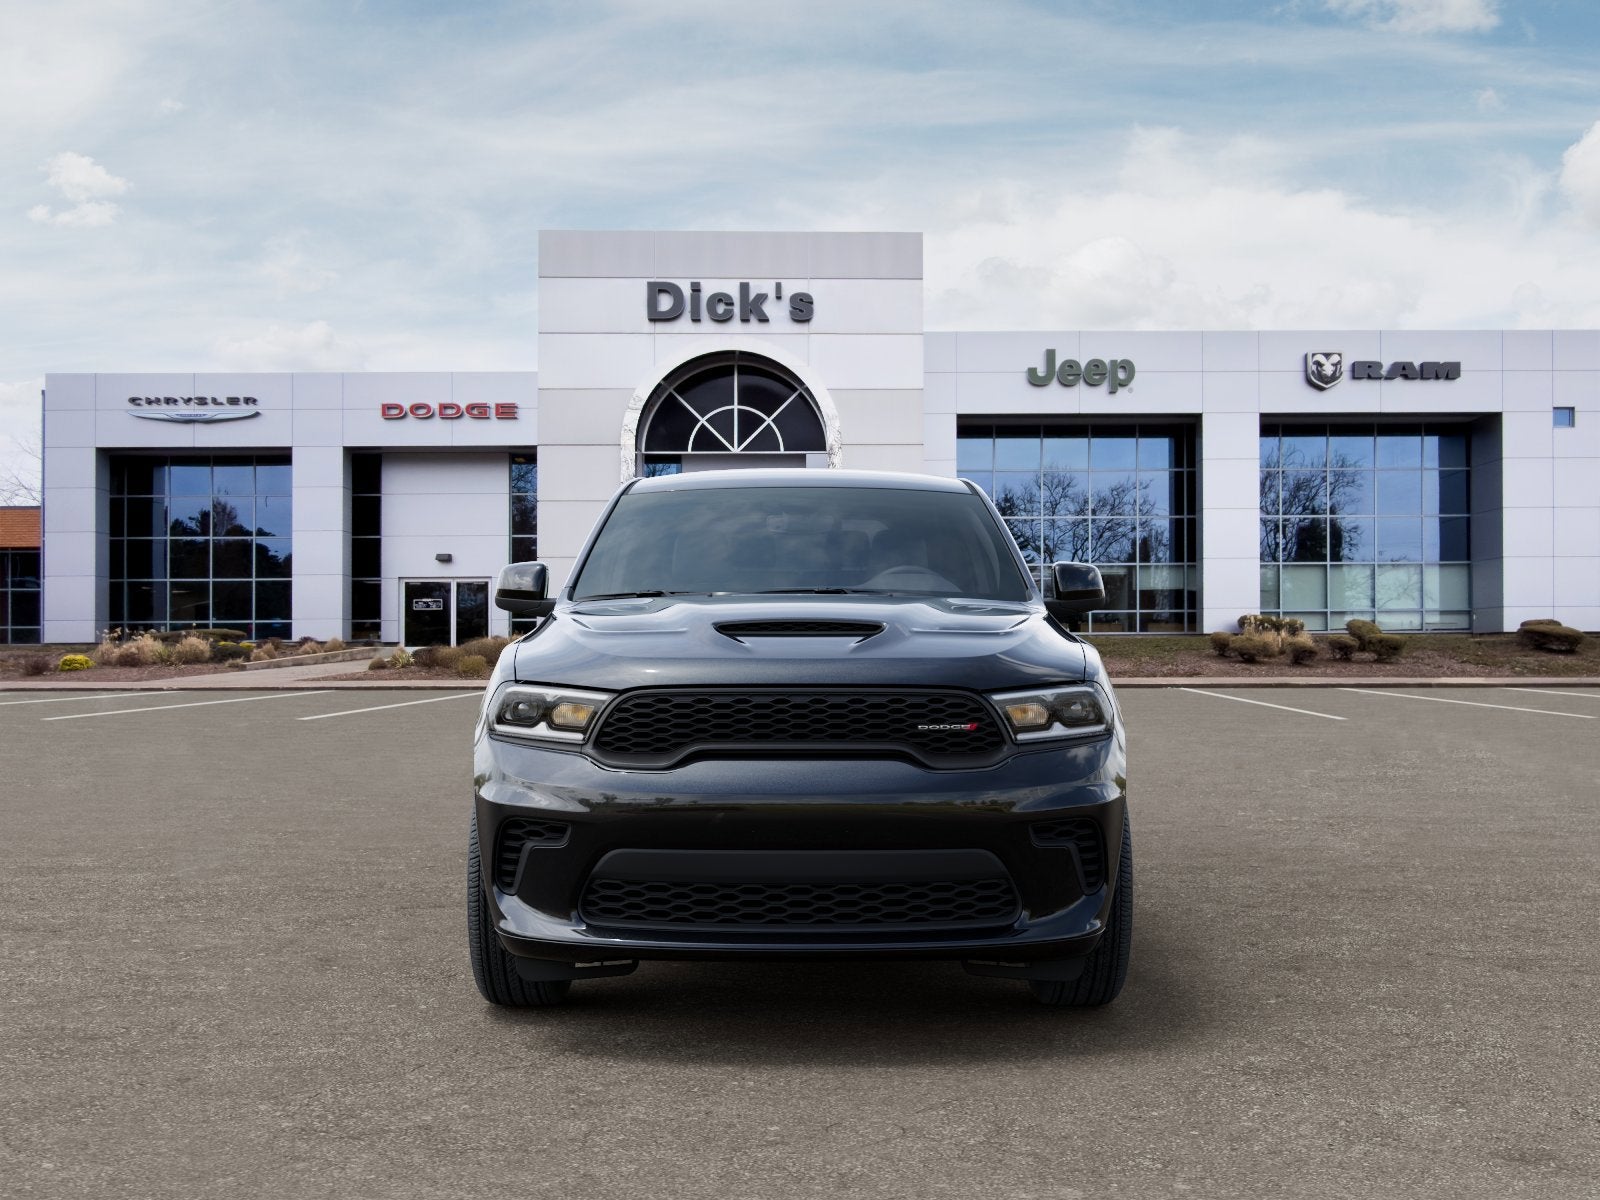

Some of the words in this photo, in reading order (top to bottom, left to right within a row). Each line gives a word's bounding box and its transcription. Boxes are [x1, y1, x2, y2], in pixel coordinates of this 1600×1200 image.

[647, 281, 814, 322] Dick's
[1027, 348, 1136, 394] Jeep
[1351, 360, 1461, 380] RAM
[127, 396, 258, 407] CHRYSLER
[381, 402, 518, 420] DODGE
